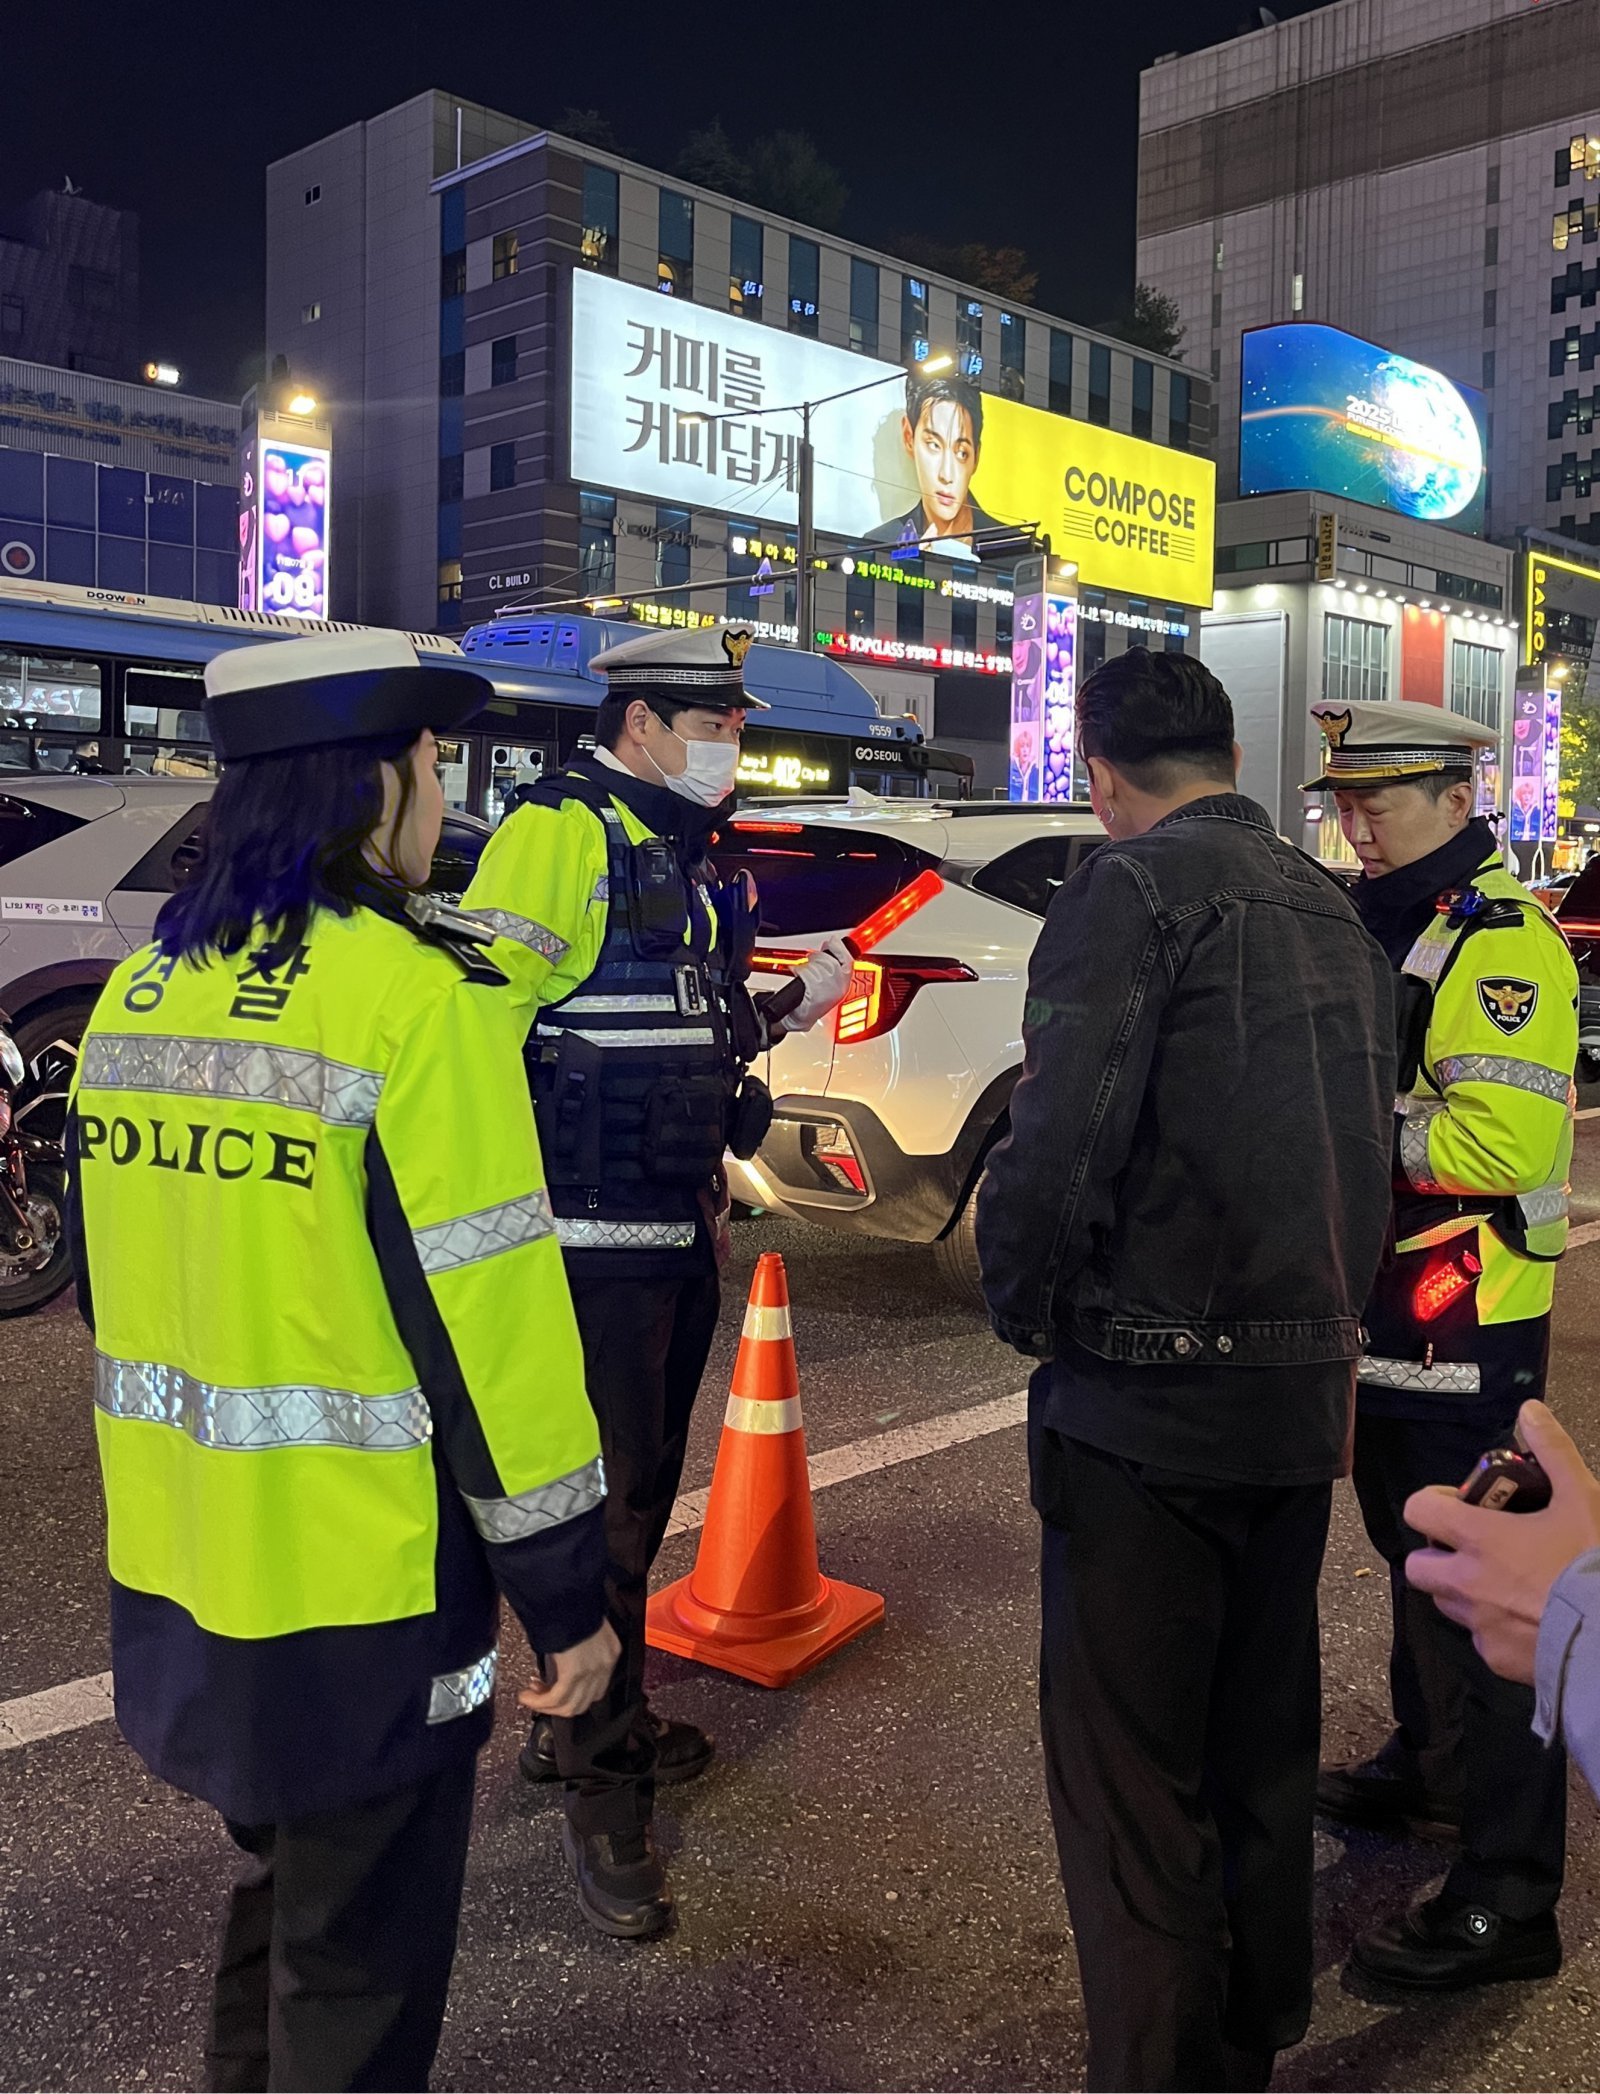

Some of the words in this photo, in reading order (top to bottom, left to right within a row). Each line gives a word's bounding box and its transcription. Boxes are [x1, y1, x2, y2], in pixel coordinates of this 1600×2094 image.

[623, 319, 765, 416] 커피를
[1346, 395, 1391, 425] 2025
[622, 395, 801, 494] 커피답게
[1064, 466, 1196, 531] COMPOSE
[1094, 515, 1170, 556] COFFEE
[749, 539, 797, 565] 제아치
[488, 575, 502, 590] CL
[505, 573, 531, 588] BUILD
[856, 560, 904, 584] 제아치과
[1533, 568, 1546, 652] BARO
[849, 634, 905, 660] TOPCLASS
[869, 724, 892, 737] 9559
[874, 750, 903, 762] SEOUL
[5, 902, 23, 910] 나의
[25, 902, 43, 915] 자랑
[62, 904, 79, 912] 우리
[81, 905, 98, 917] 중랑
[1496, 1014, 1521, 1023] POLICE
[77, 1114, 317, 1191] POLICE
